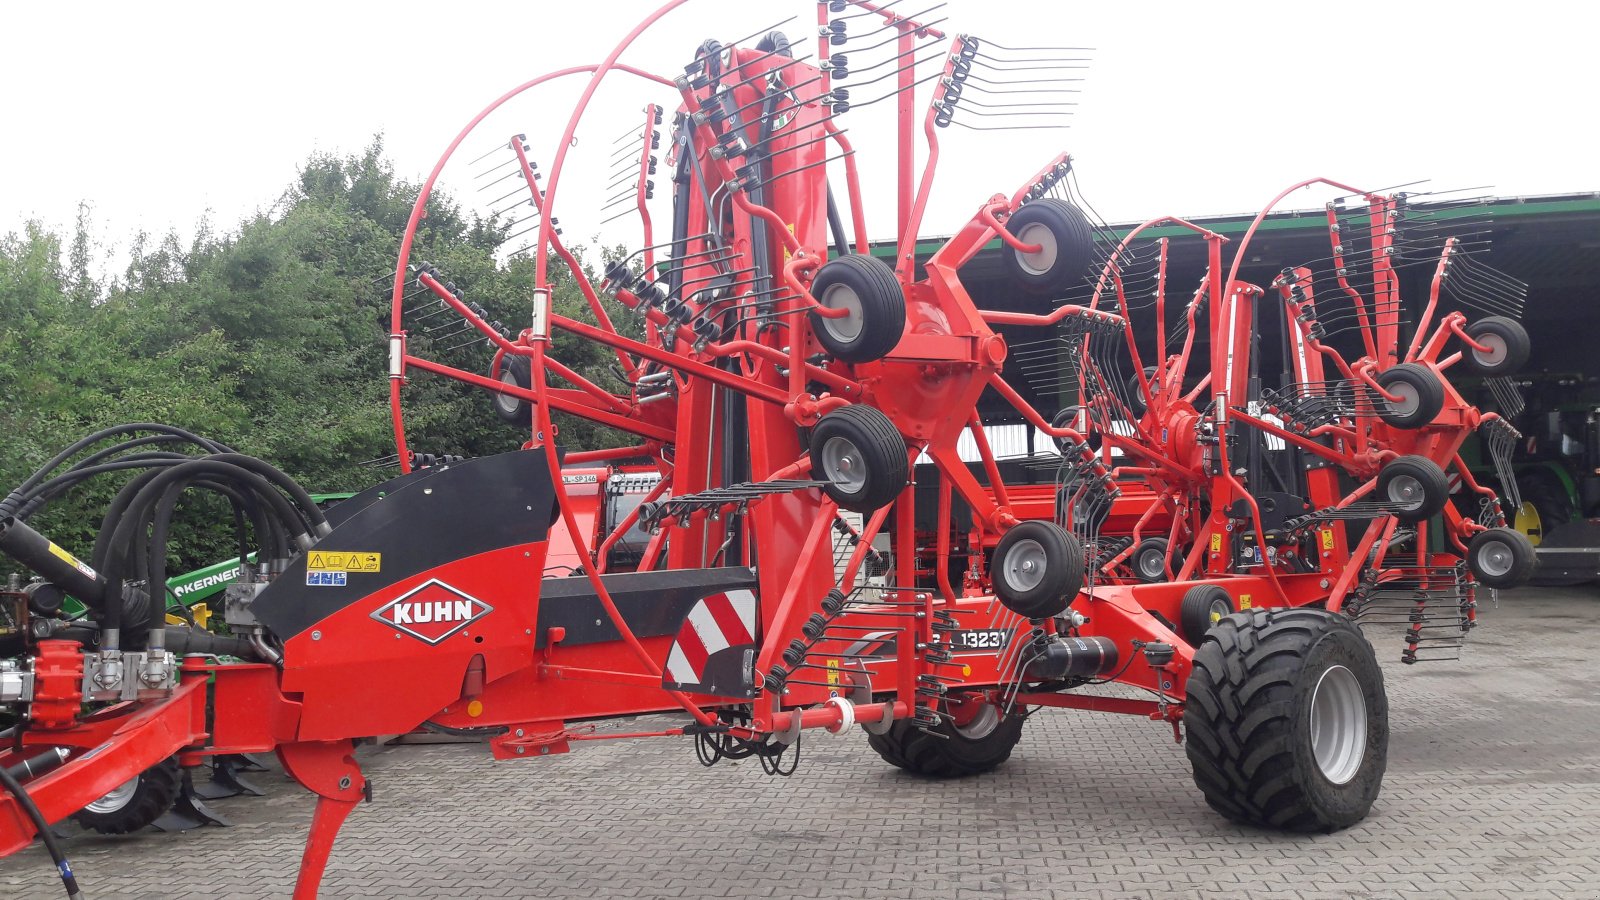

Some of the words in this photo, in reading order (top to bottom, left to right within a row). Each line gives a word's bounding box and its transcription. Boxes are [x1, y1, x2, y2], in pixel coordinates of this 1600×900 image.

[183, 567, 241, 594] KERNER
[393, 600, 472, 625] KUHN
[961, 632, 1007, 648] 13231
